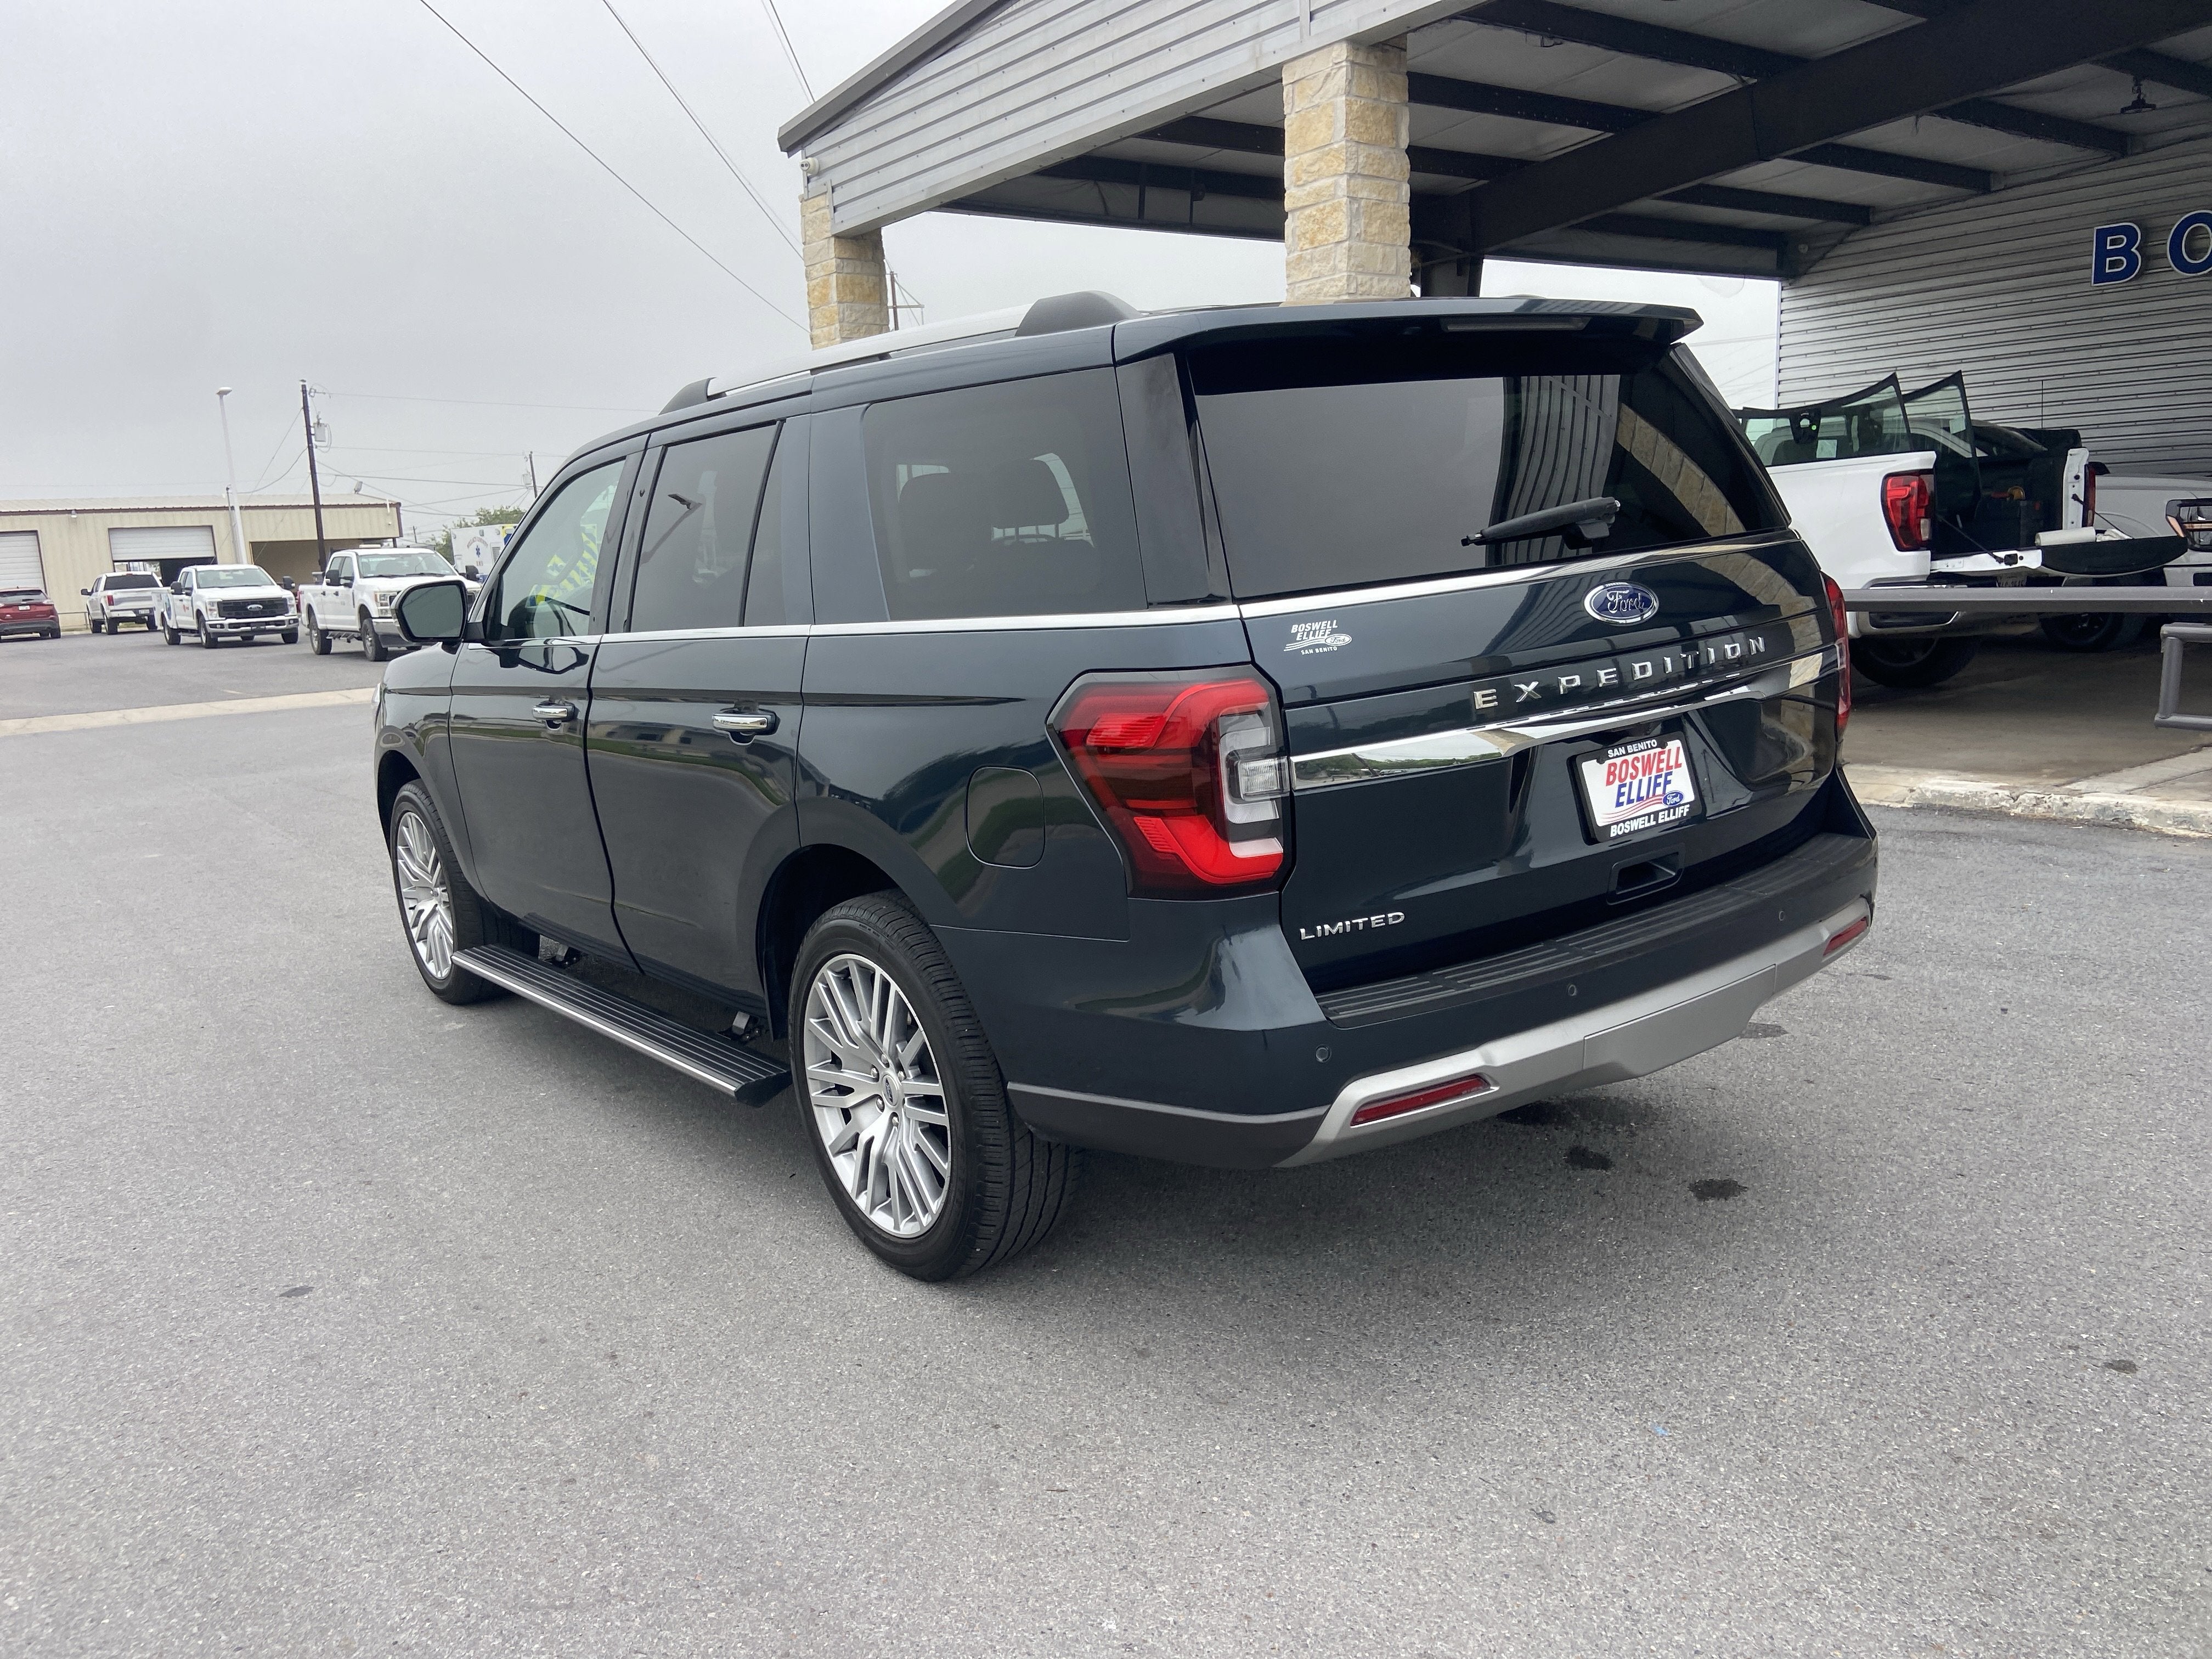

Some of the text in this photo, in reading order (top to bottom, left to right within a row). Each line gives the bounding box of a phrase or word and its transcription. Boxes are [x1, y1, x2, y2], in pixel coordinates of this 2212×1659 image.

[2091, 210, 2212, 286] BO
[1607, 590, 1645, 613] Ford
[1291, 619, 1338, 633] BOSWELL
[1296, 628, 1332, 641] ELLIFF
[1474, 636, 1766, 710] EXPEDITION
[1607, 739, 1657, 758] SAN BENITO
[1605, 746, 1682, 787] BOSWELL
[1615, 771, 1673, 808] ELLIFF
[1666, 792, 1680, 805] Ford
[1610, 804, 1690, 837] BOSWELL ELLIFF
[1300, 912, 1405, 940] LIMITED
